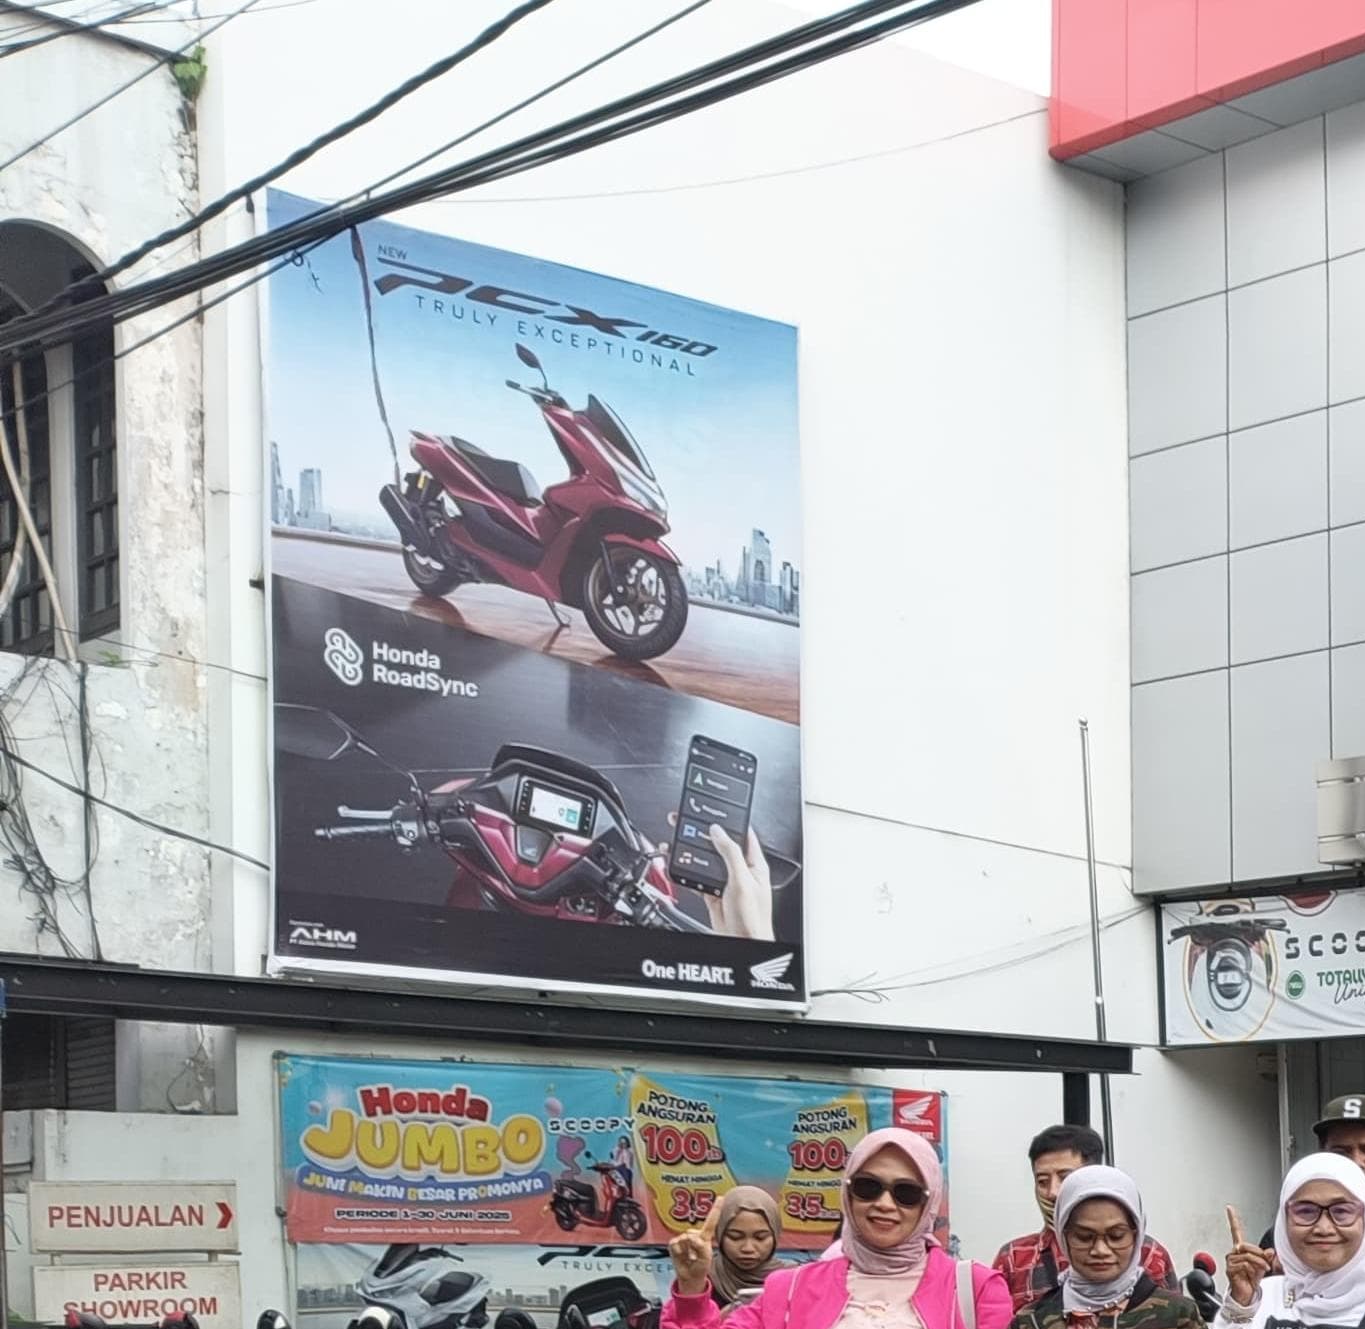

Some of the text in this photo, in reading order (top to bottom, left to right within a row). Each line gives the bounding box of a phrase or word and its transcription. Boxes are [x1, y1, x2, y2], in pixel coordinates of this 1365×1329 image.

[378, 245, 407, 260] NEW
[416, 295, 696, 376] TRULY EXCEPTIONAL
[373, 642, 440, 669] Honda
[373, 664, 478, 697] RoadSync
[290, 927, 357, 943] AHM
[641, 959, 676, 980] One
[359, 1087, 490, 1120] Honda
[650, 1091, 709, 1113] POTONG
[1343, 1098, 1362, 1118] S
[637, 1102, 717, 1125] ANGSURAN
[798, 1106, 848, 1123] POTONG
[549, 1119, 635, 1132] SCOOPY
[792, 1118, 857, 1135] ANGSURAN
[304, 1111, 543, 1176] JUMBO
[303, 1172, 345, 1192] JUNI
[349, 1180, 405, 1199] MAKIN
[458, 1178, 544, 1200] PROMONYA
[48, 1204, 204, 1229] PENJUALAN
[335, 1209, 511, 1221] PERIODE 1-30 JUNI 2025
[562, 1260, 673, 1274] TRULY EXCEP
[93, 1271, 187, 1292] PARKIR
[63, 1297, 218, 1322] SHOWROOM
